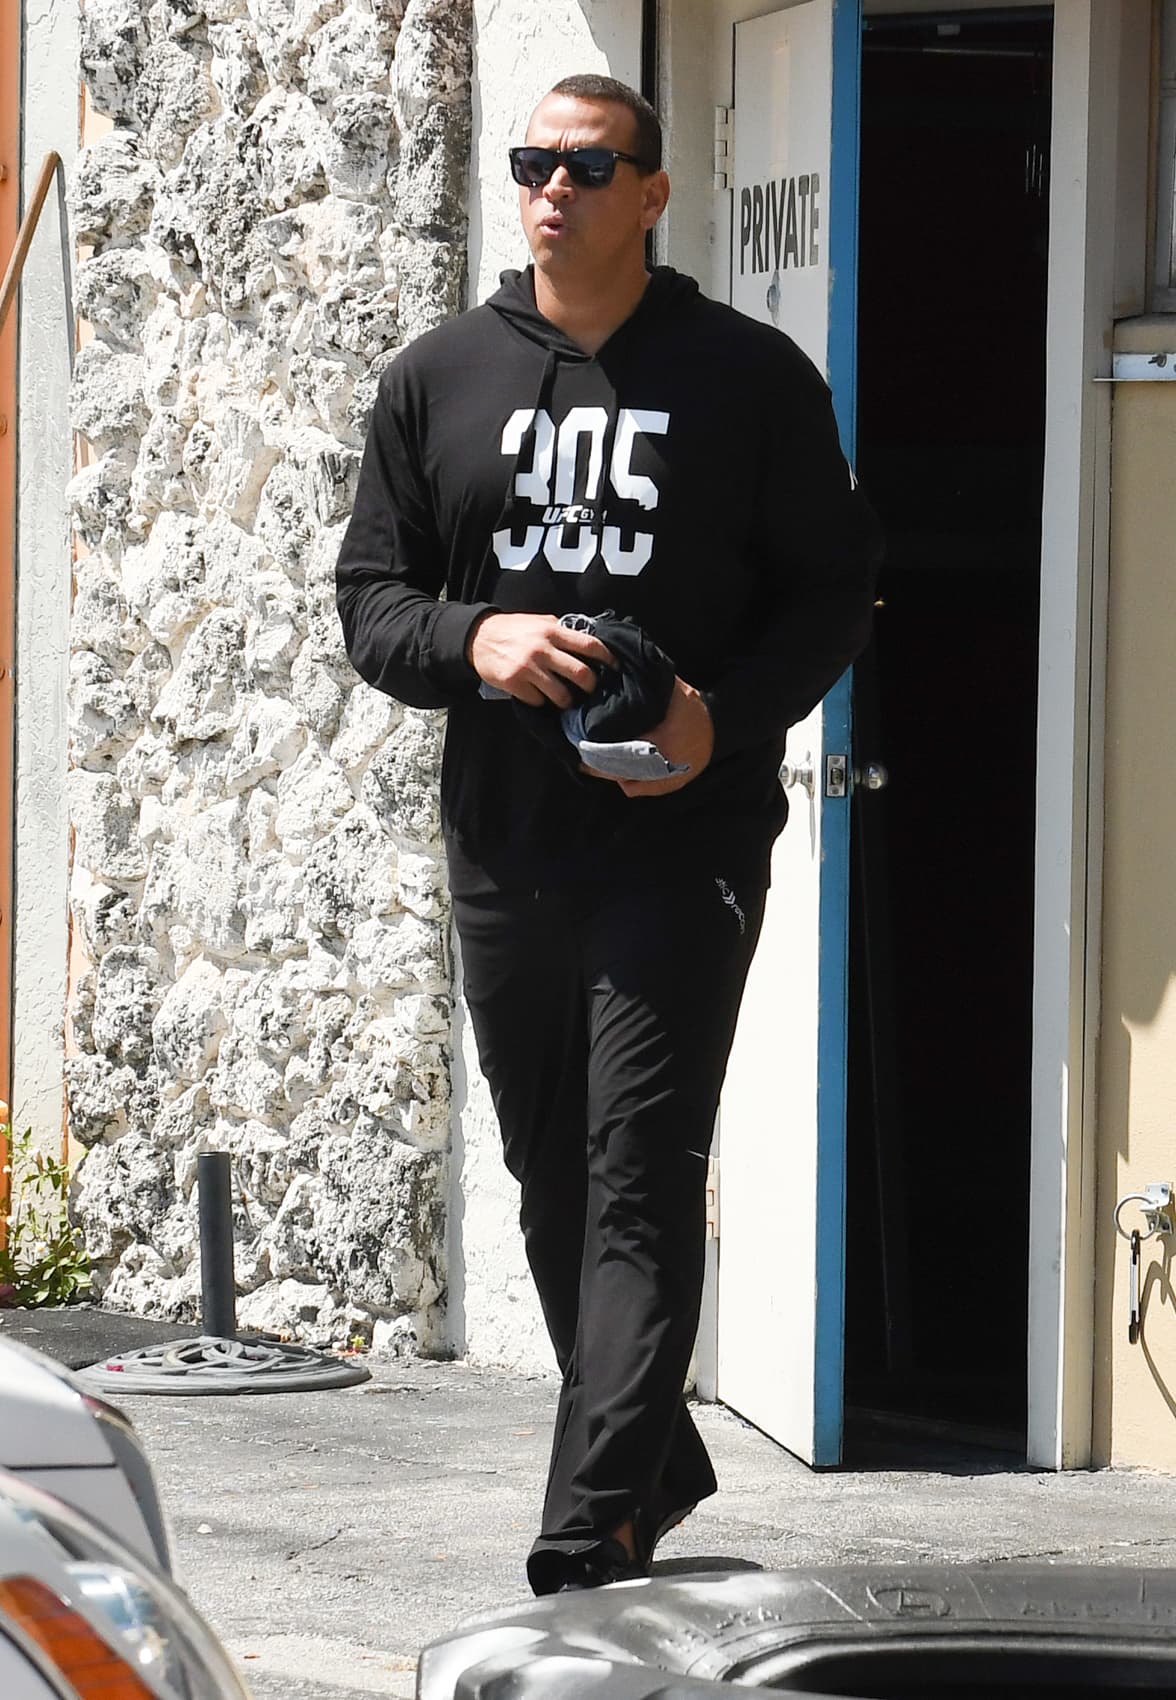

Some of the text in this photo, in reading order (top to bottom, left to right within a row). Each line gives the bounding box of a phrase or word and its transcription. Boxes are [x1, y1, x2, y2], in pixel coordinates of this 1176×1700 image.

[741, 173, 820, 275] PRIVATE
[492, 406, 671, 576] 305
[542, 504, 583, 524] UFC
